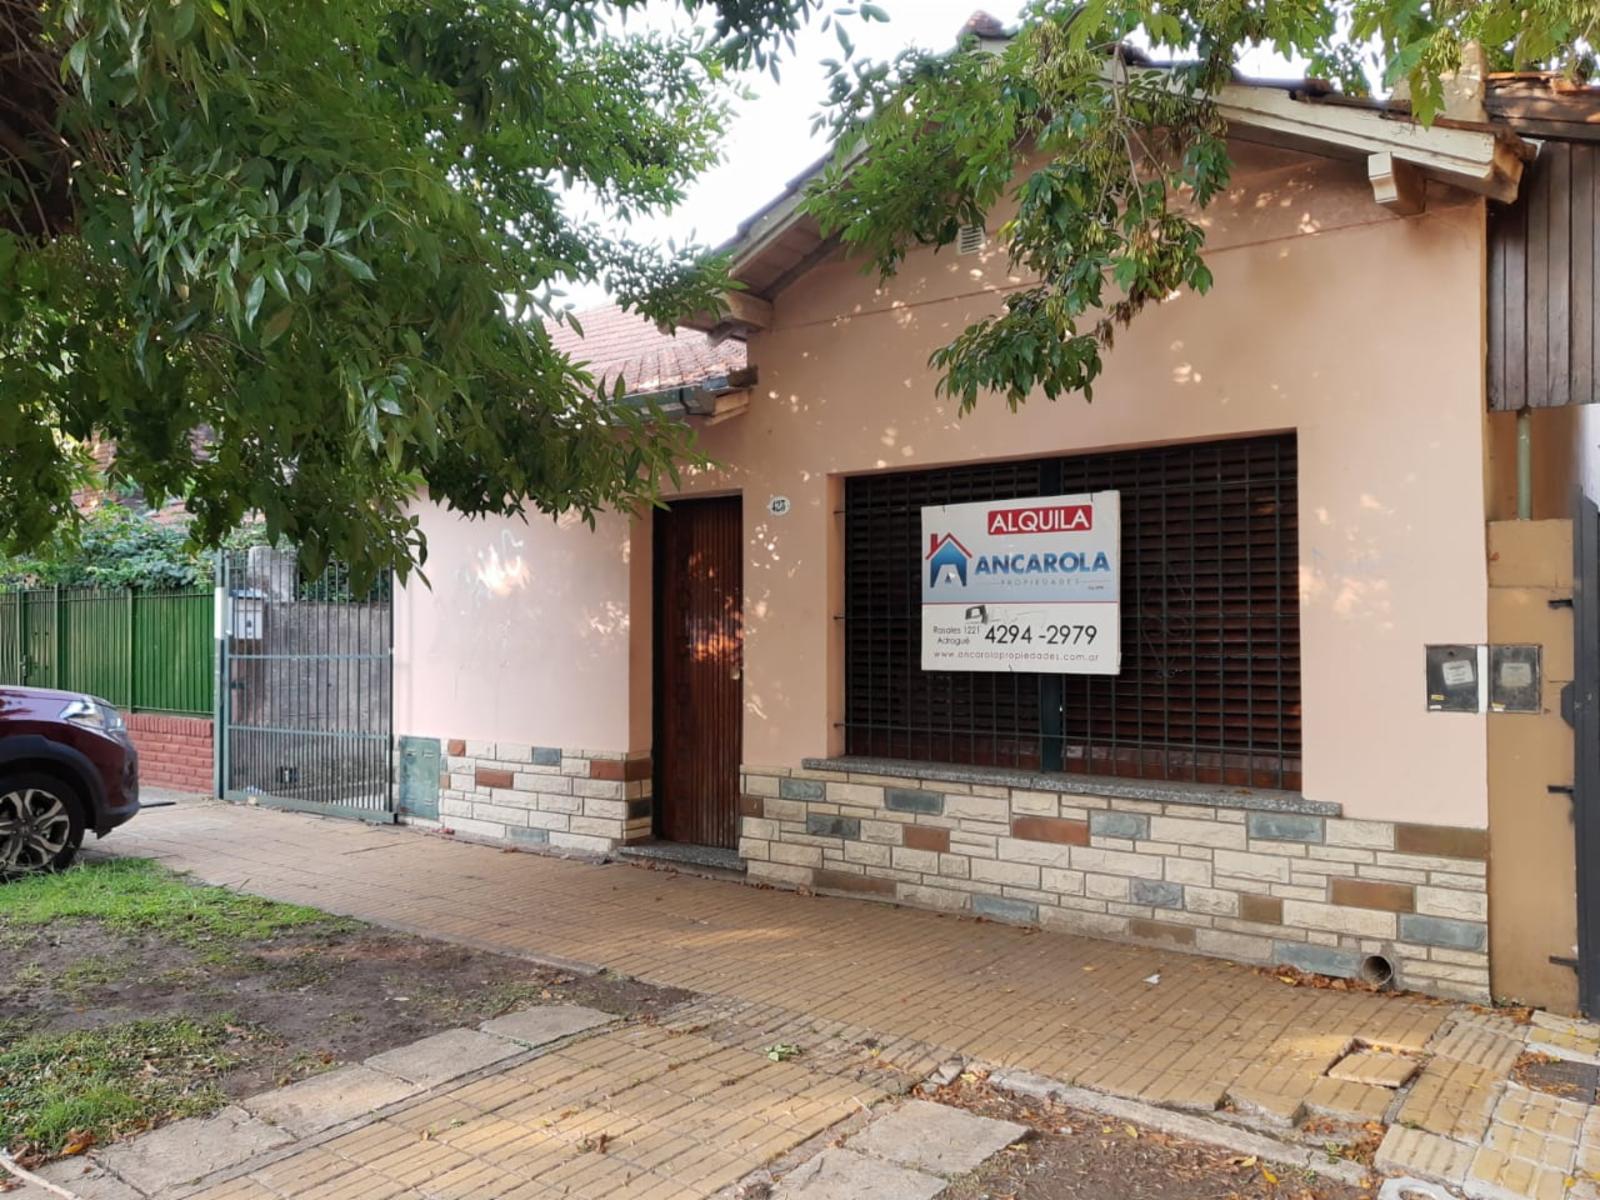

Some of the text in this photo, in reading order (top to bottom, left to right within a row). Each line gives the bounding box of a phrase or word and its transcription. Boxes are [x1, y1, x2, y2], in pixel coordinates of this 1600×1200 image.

[990, 509, 1089, 532] ALQUILA
[975, 551, 1110, 575] ANCAROLA
[1001, 577, 1080, 586] PROPIEDADES
[933, 625, 961, 635] Rosales
[964, 624, 980, 635] 1221
[985, 625, 1032, 644] 4294
[933, 650, 1099, 662] www.ancarolapropiedades.com.ar
